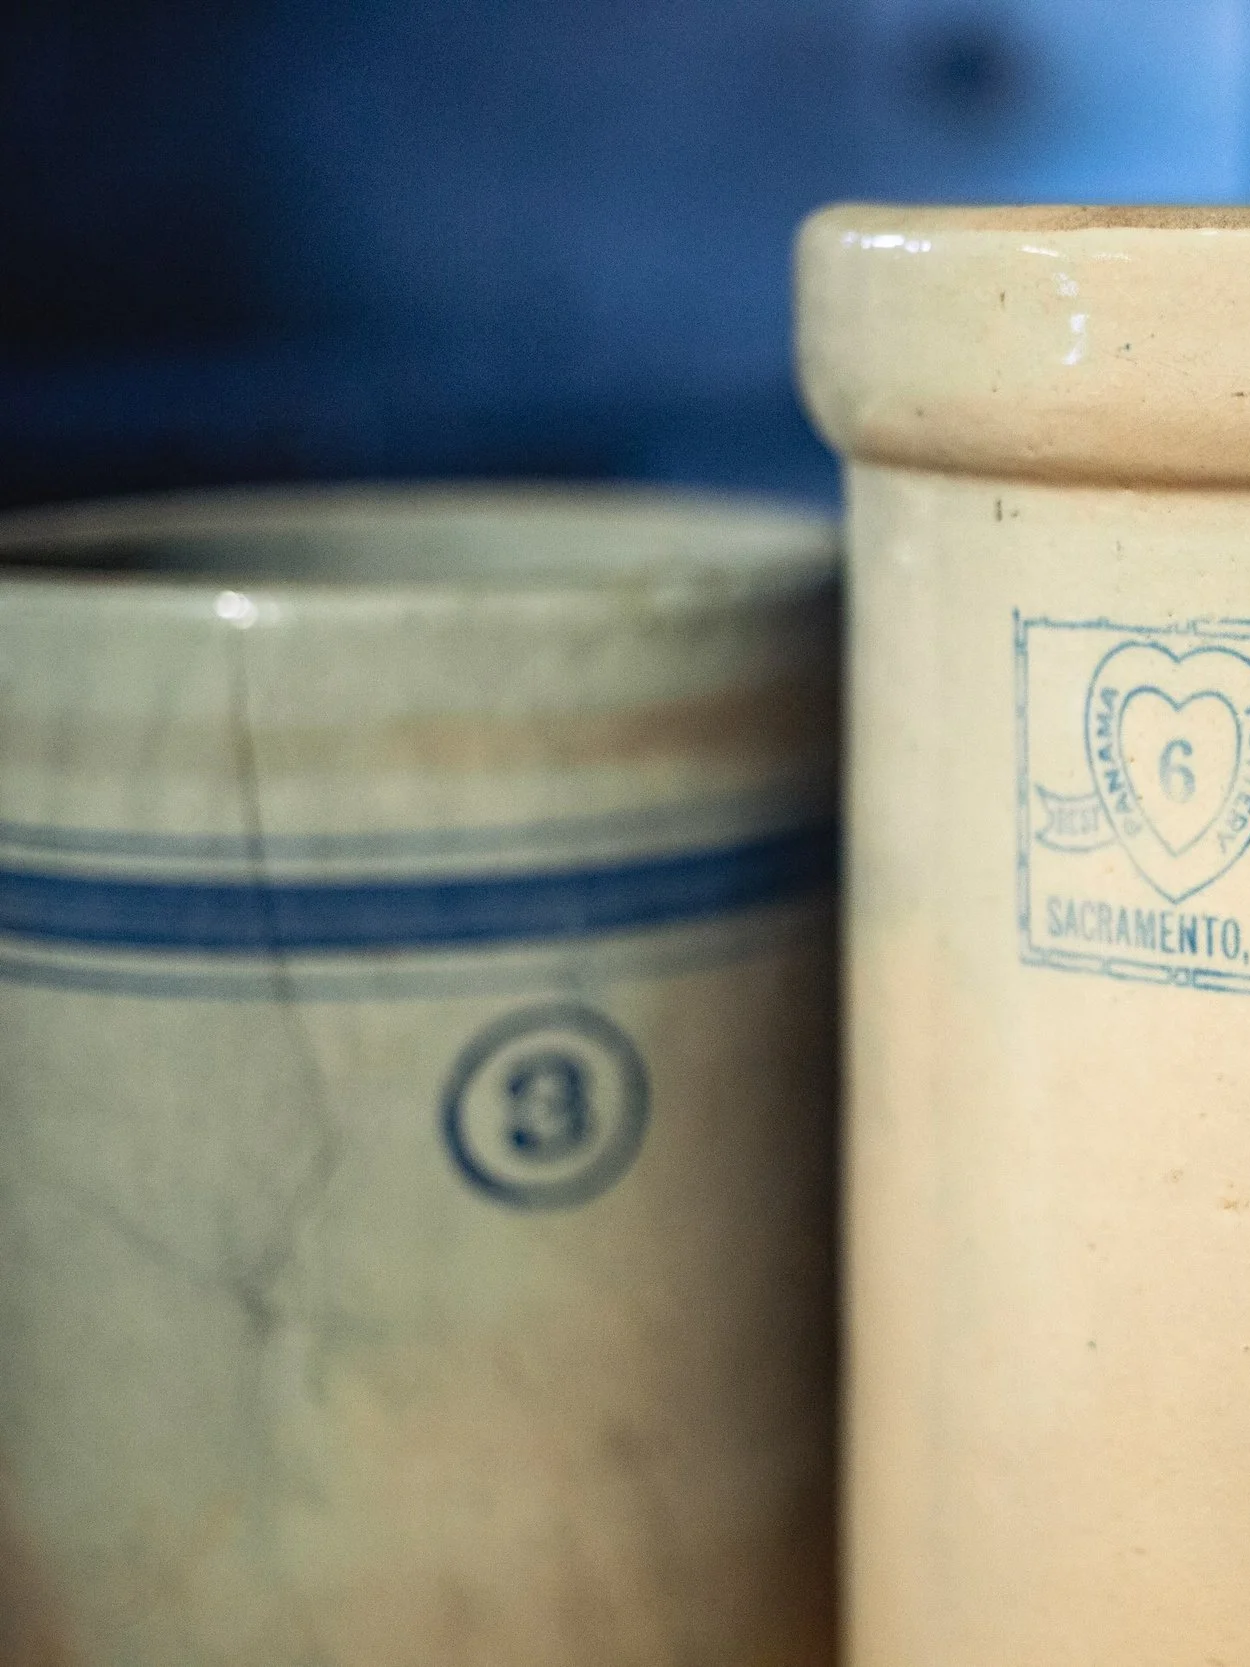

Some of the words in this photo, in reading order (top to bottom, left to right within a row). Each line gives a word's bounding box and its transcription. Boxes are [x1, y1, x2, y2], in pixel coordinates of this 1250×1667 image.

[1159, 738, 1197, 804] 6
[1046, 897, 1249, 965] SACRAMENTO,
[505, 1051, 590, 1163] 3
